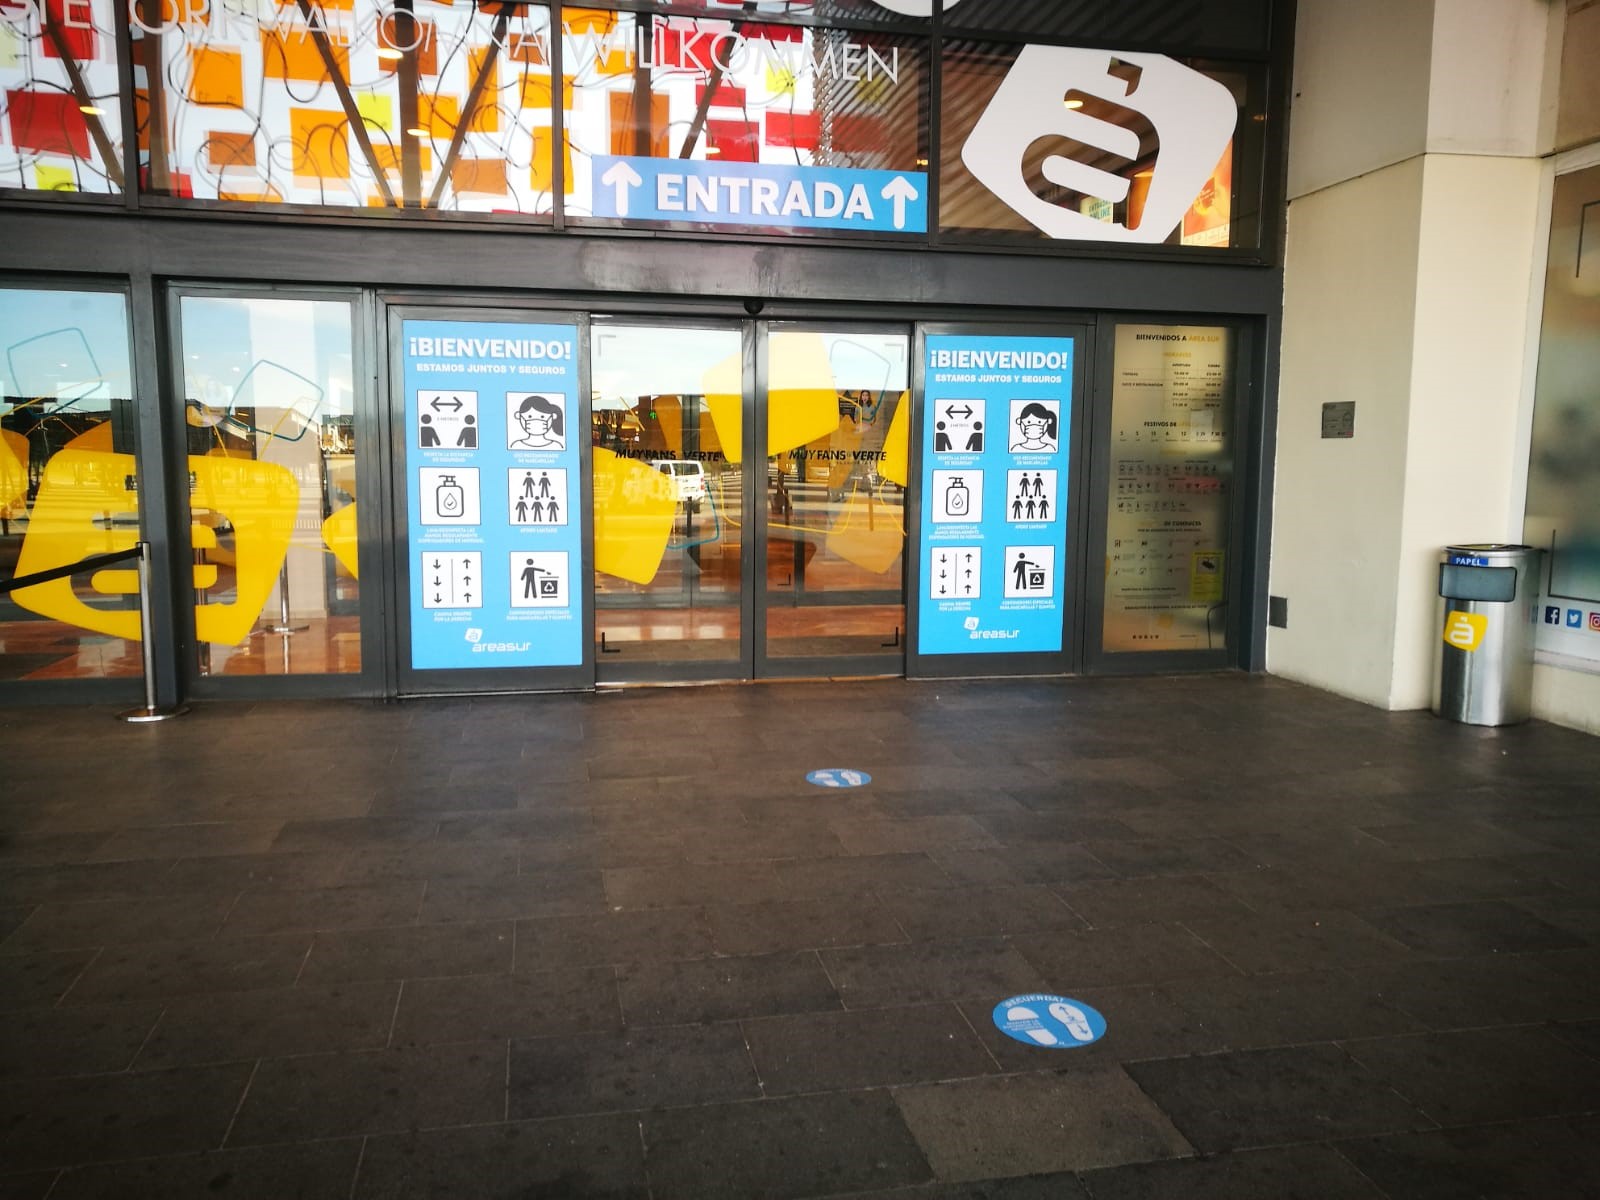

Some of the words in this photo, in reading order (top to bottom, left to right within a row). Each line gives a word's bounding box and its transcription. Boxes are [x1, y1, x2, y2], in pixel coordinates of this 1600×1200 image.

[563, 22, 899, 85] WILLKOMMEN
[656, 173, 874, 221] ENTRADA
[1135, 333, 1180, 342] BIENVENIDOS
[409, 337, 571, 360] ¡BIENVENIDO!
[930, 350, 1068, 370] ¡BIENVENIDO!
[416, 363, 465, 373] ESTAMOS
[467, 364, 506, 374] JUNTOS
[509, 366, 516, 374] Y
[519, 366, 566, 375] SEGUROS
[935, 374, 976, 383] ESTAMOS
[978, 374, 1012, 383] JUNTOS
[1014, 375, 1020, 383] Y
[1022, 375, 1062, 384] SEGUROS
[852, 450, 887, 462] VERTE
[1456, 557, 1481, 567] PAPEL
[970, 630, 1020, 640] areasur
[472, 641, 532, 653] areasur
